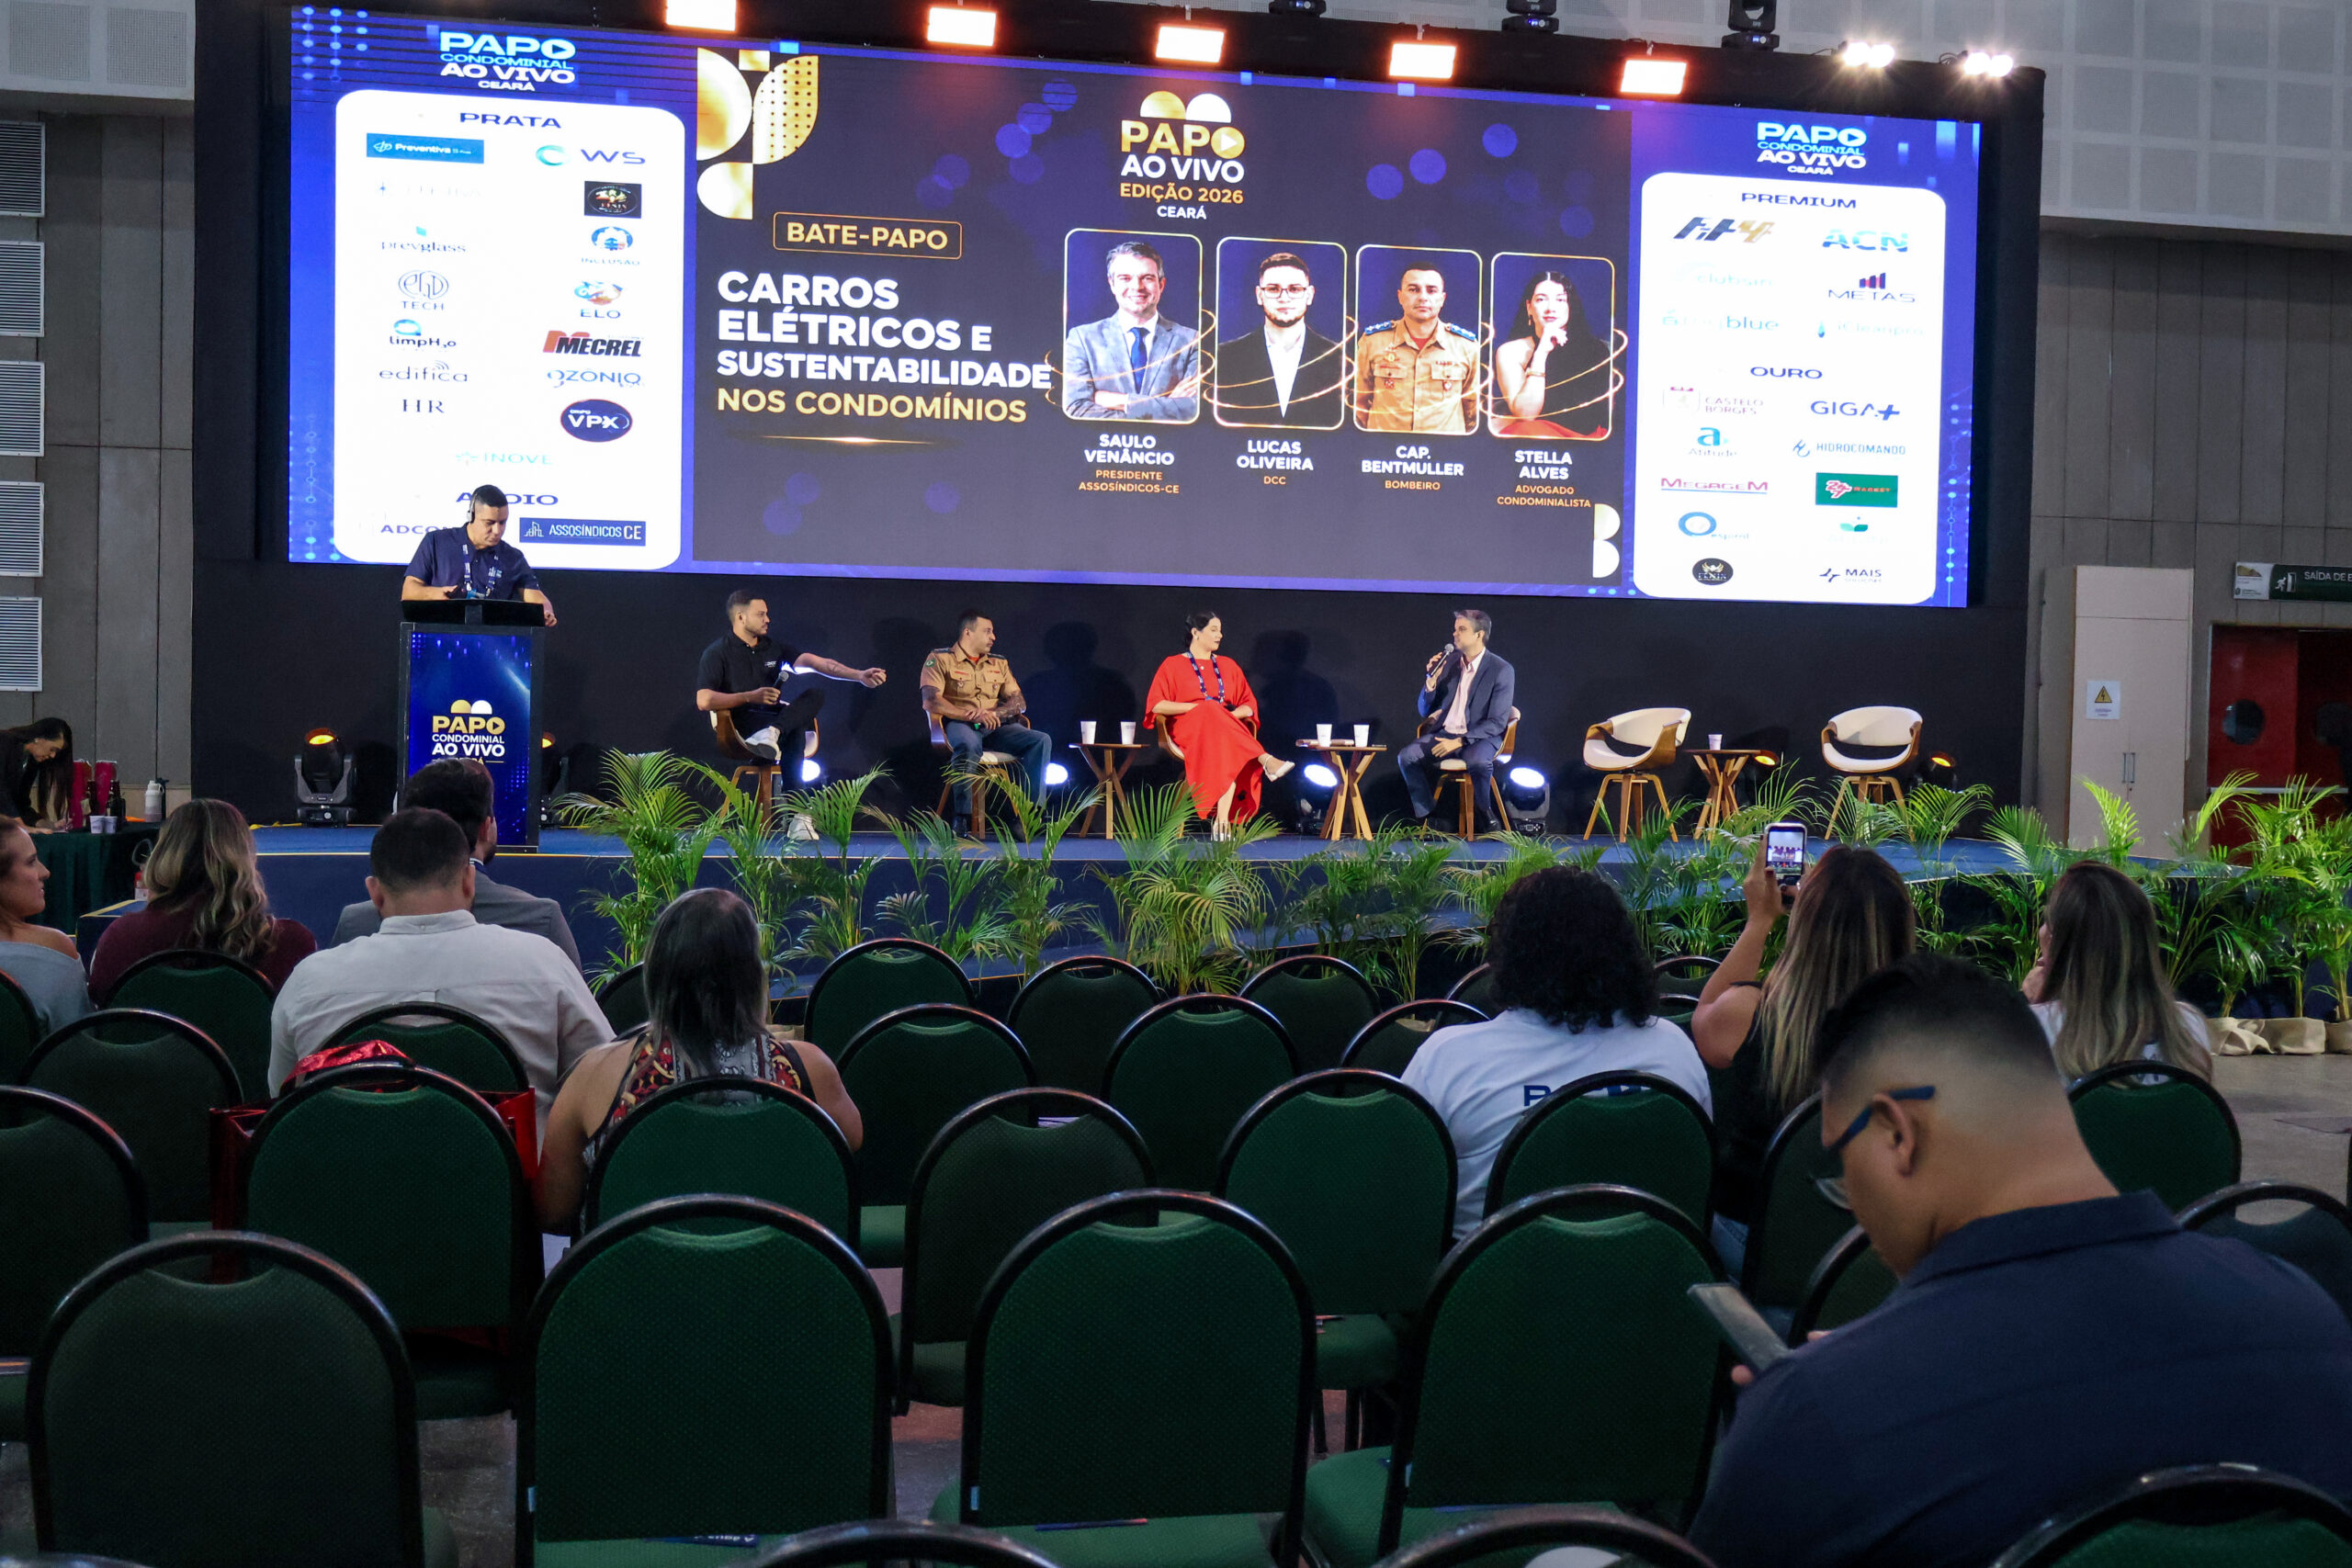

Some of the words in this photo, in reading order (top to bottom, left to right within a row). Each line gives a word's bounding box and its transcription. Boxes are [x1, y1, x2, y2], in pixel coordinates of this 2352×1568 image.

[439, 31, 576, 60] PAPO
[439, 53, 574, 70] CONDOMINIAL
[440, 62, 488, 79] AO
[492, 65, 576, 84] VIVO
[478, 80, 535, 91] CEARÁ
[459, 112, 562, 129] PRATA
[1121, 120, 1245, 159] PAPO
[1757, 121, 1867, 147] PAPO
[395, 142, 451, 153] Preventiva
[1757, 141, 1865, 156] CONDOMINIAL
[581, 148, 646, 164] WS
[1757, 150, 1795, 164] AO
[1800, 152, 1866, 169] VIVO
[1120, 154, 1166, 178] AO
[1171, 157, 1245, 183] VIVO
[1787, 165, 1834, 175] CEARÁ
[1120, 182, 1193, 203] EDIÇÃO
[1198, 187, 1244, 204] 2026
[1741, 193, 1857, 209] PREMIUM
[1157, 205, 1207, 220] CEARÁ
[786, 221, 948, 250] BATE-PAPO
[1822, 229, 1908, 253] ACN
[380, 239, 467, 254] prevglass
[718, 271, 899, 310] CARROS
[1828, 289, 1916, 304] METAS
[401, 300, 445, 310] TECH
[580, 309, 621, 320] ELO
[718, 306, 961, 351] ELÉTRICOS
[971, 325, 992, 352] E
[555, 336, 641, 357] MECREL
[379, 366, 468, 383] edifica
[717, 349, 1052, 389] SUSTENTABILIDADE
[1749, 367, 1823, 379] OURO
[717, 388, 786, 412] NOS
[796, 392, 1027, 423] CONDOMÍNIOS
[567, 414, 620, 429] VPX
[1099, 434, 1157, 449] SAULO
[1247, 440, 1302, 455] LUCAS
[1084, 448, 1175, 465] VENÂNCIO
[1395, 446, 1430, 459] CAP.
[1816, 443, 1906, 456] HIDROCOMANDO
[482, 452, 554, 466] INOVE
[1236, 455, 1314, 470] OLIVEIRA
[1514, 450, 1572, 465] STELLA
[1095, 469, 1162, 480] PRESIDENTE
[1361, 460, 1464, 476] BENTMULLER
[1519, 466, 1568, 480] ALVES
[1078, 480, 1180, 494] ASSOSÍNDICOS-CE
[1263, 476, 1286, 485] DCC
[1385, 480, 1441, 491] BOMBEIRO
[1515, 485, 1574, 495] ADVOGADO
[456, 491, 559, 506] AOIO
[1497, 496, 1591, 507] CONDOMINIALISTA
[548, 524, 622, 538] ASSOSÍNDICOS
[623, 525, 642, 540] CE
[1845, 569, 1882, 578] MAIS
[2304, 570, 2332, 581] SAÍDA
[2334, 573, 2346, 581] DE
[433, 716, 505, 735] PAPO
[432, 734, 504, 744] CONDOMINIAL
[432, 743, 458, 756] AO
[462, 743, 505, 757] VIVO
